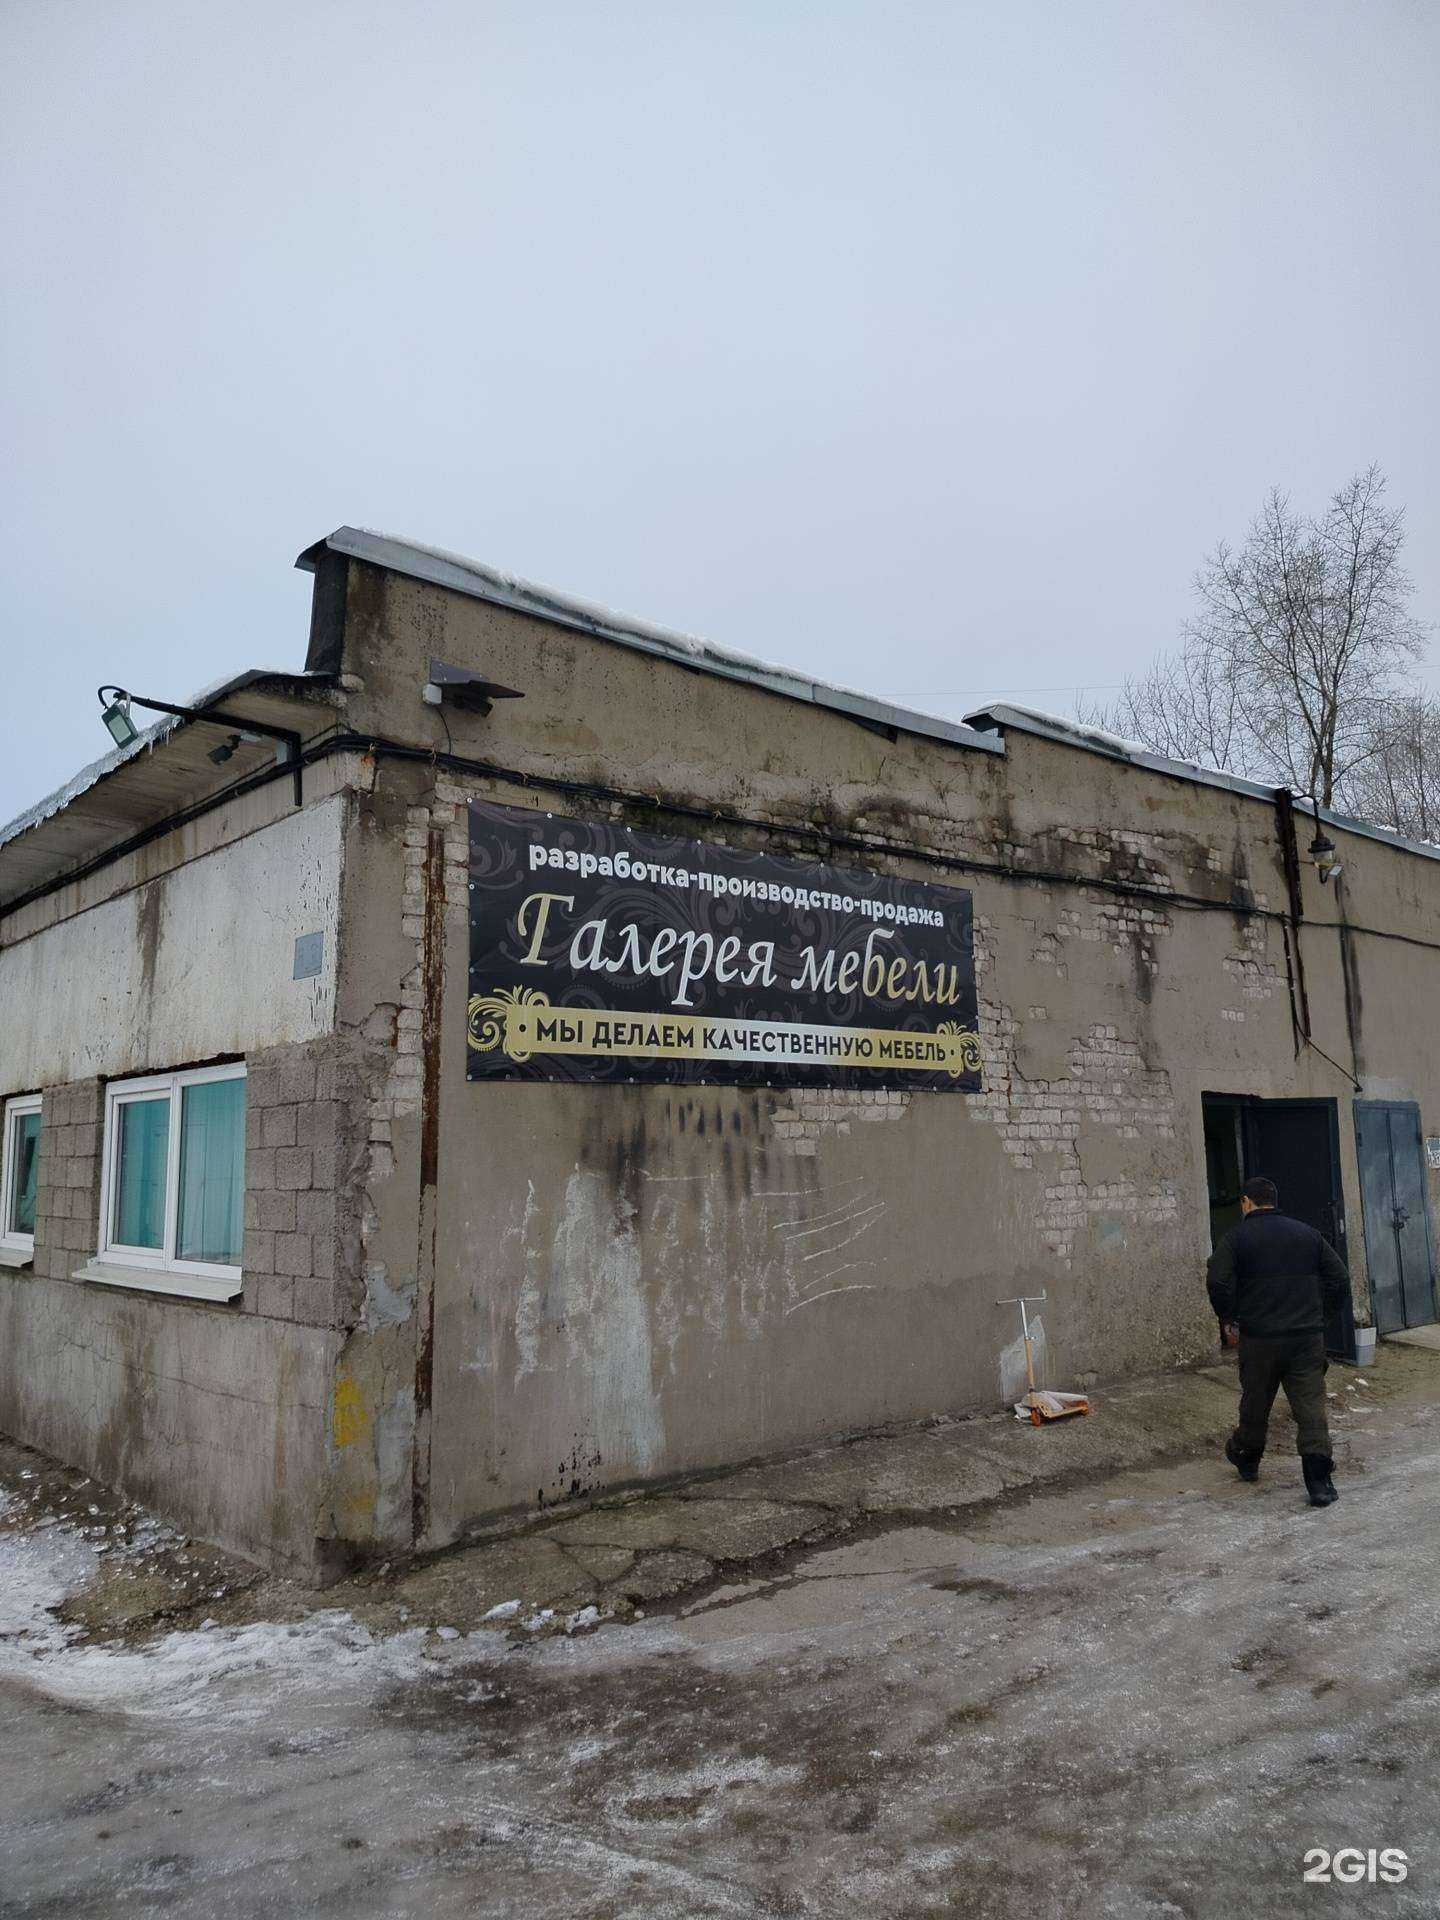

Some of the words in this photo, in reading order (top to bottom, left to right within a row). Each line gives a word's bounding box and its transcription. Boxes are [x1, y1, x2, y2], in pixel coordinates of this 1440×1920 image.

[529, 844, 944, 928] разработка-производство-продажа
[517, 892, 778, 1007] Галерея
[790, 927, 960, 1005] мебели
[536, 1017, 584, 1043] МЫ
[592, 1019, 695, 1049] ДЕЛАЕМ
[702, 1027, 873, 1058] КАЧЕСТВЕННУЮ
[879, 1039, 946, 1062] МЕБЕЛЬ
